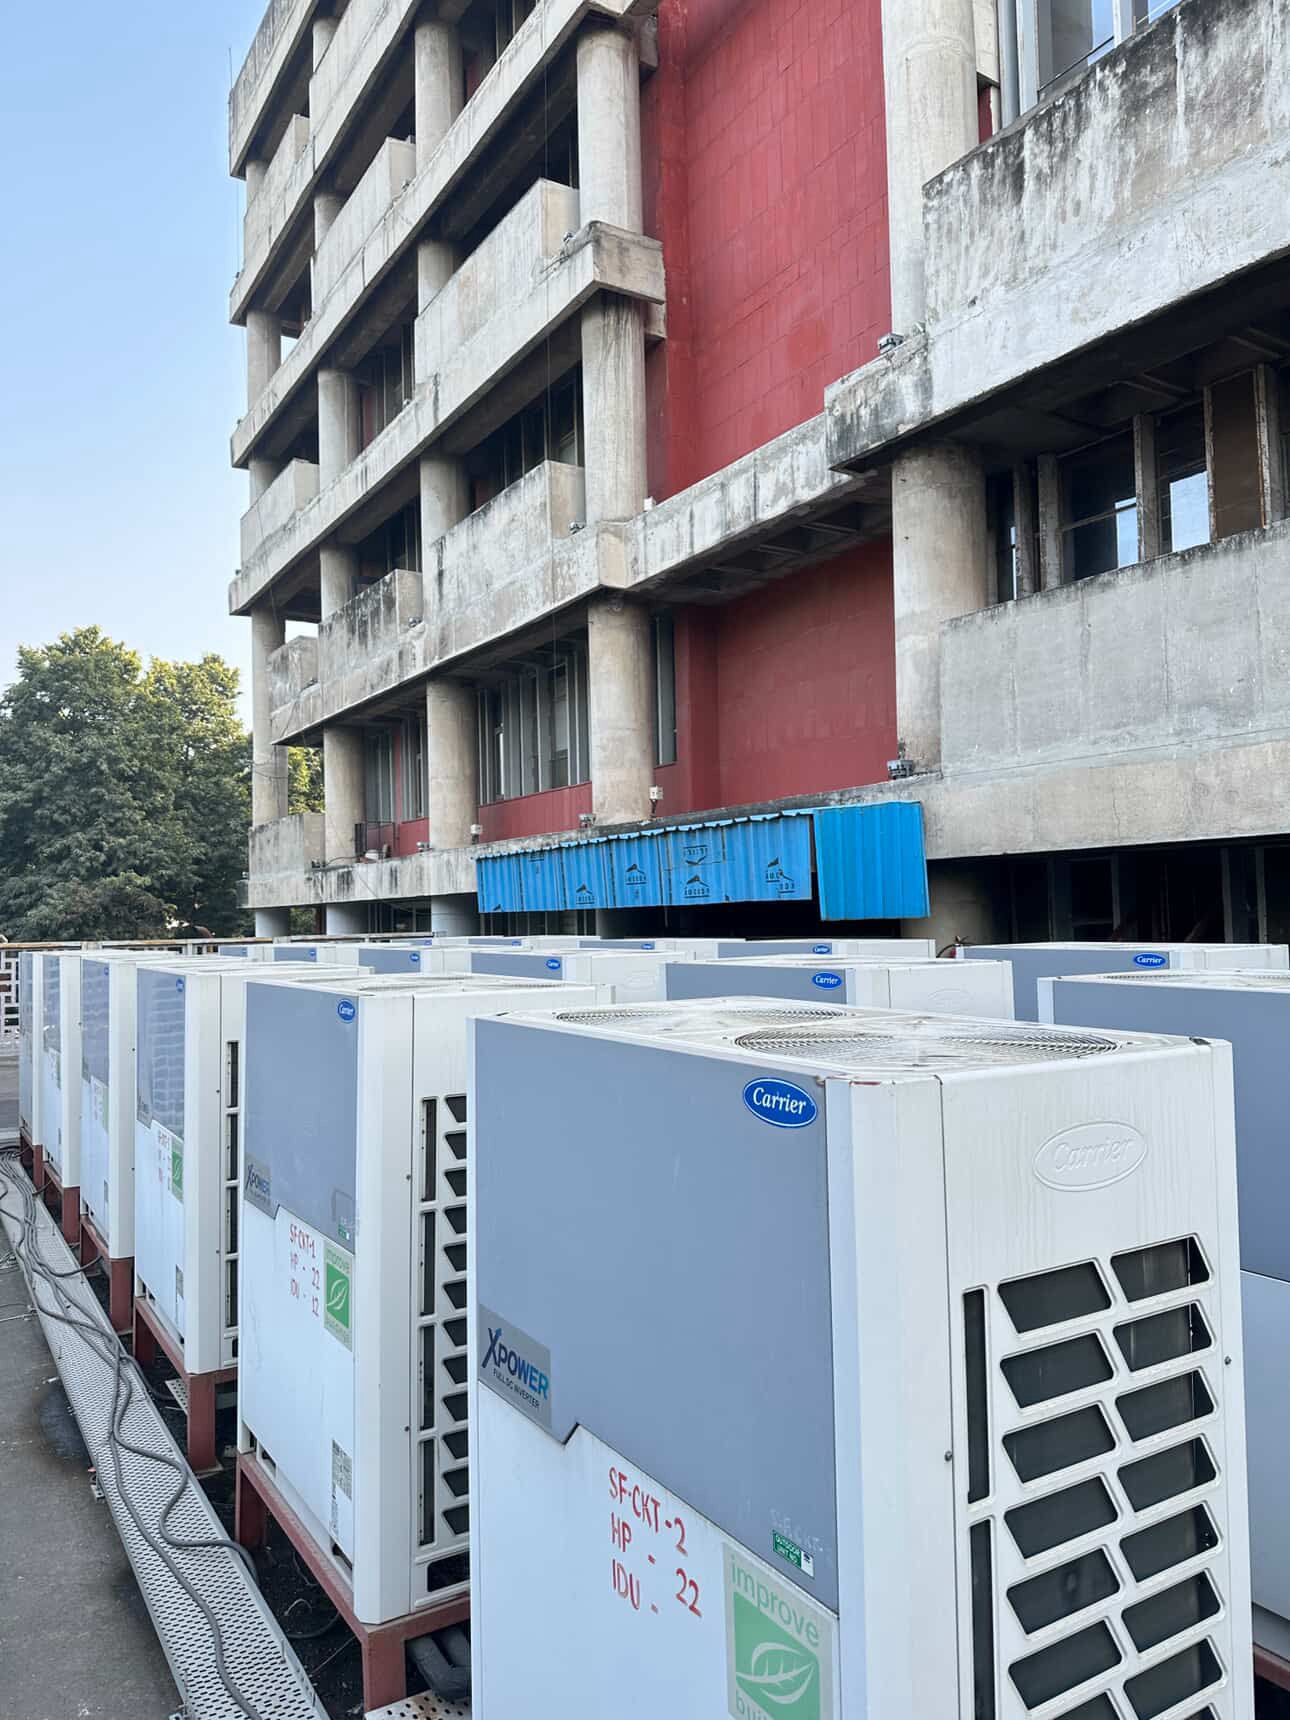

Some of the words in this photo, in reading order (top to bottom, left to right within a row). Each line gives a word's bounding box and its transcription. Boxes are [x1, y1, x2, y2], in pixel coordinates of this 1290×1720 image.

[815, 975, 839, 985] Carrier
[752, 1087, 807, 1115] Carrier
[1055, 1137, 1133, 1173] Carrier
[481, 1327, 549, 1401] XPOWER
[611, 1512, 632, 1552] HP
[675, 1568, 702, 1618] 22
[612, 1558, 641, 1610] IDU
[731, 1554, 821, 1648] improve
